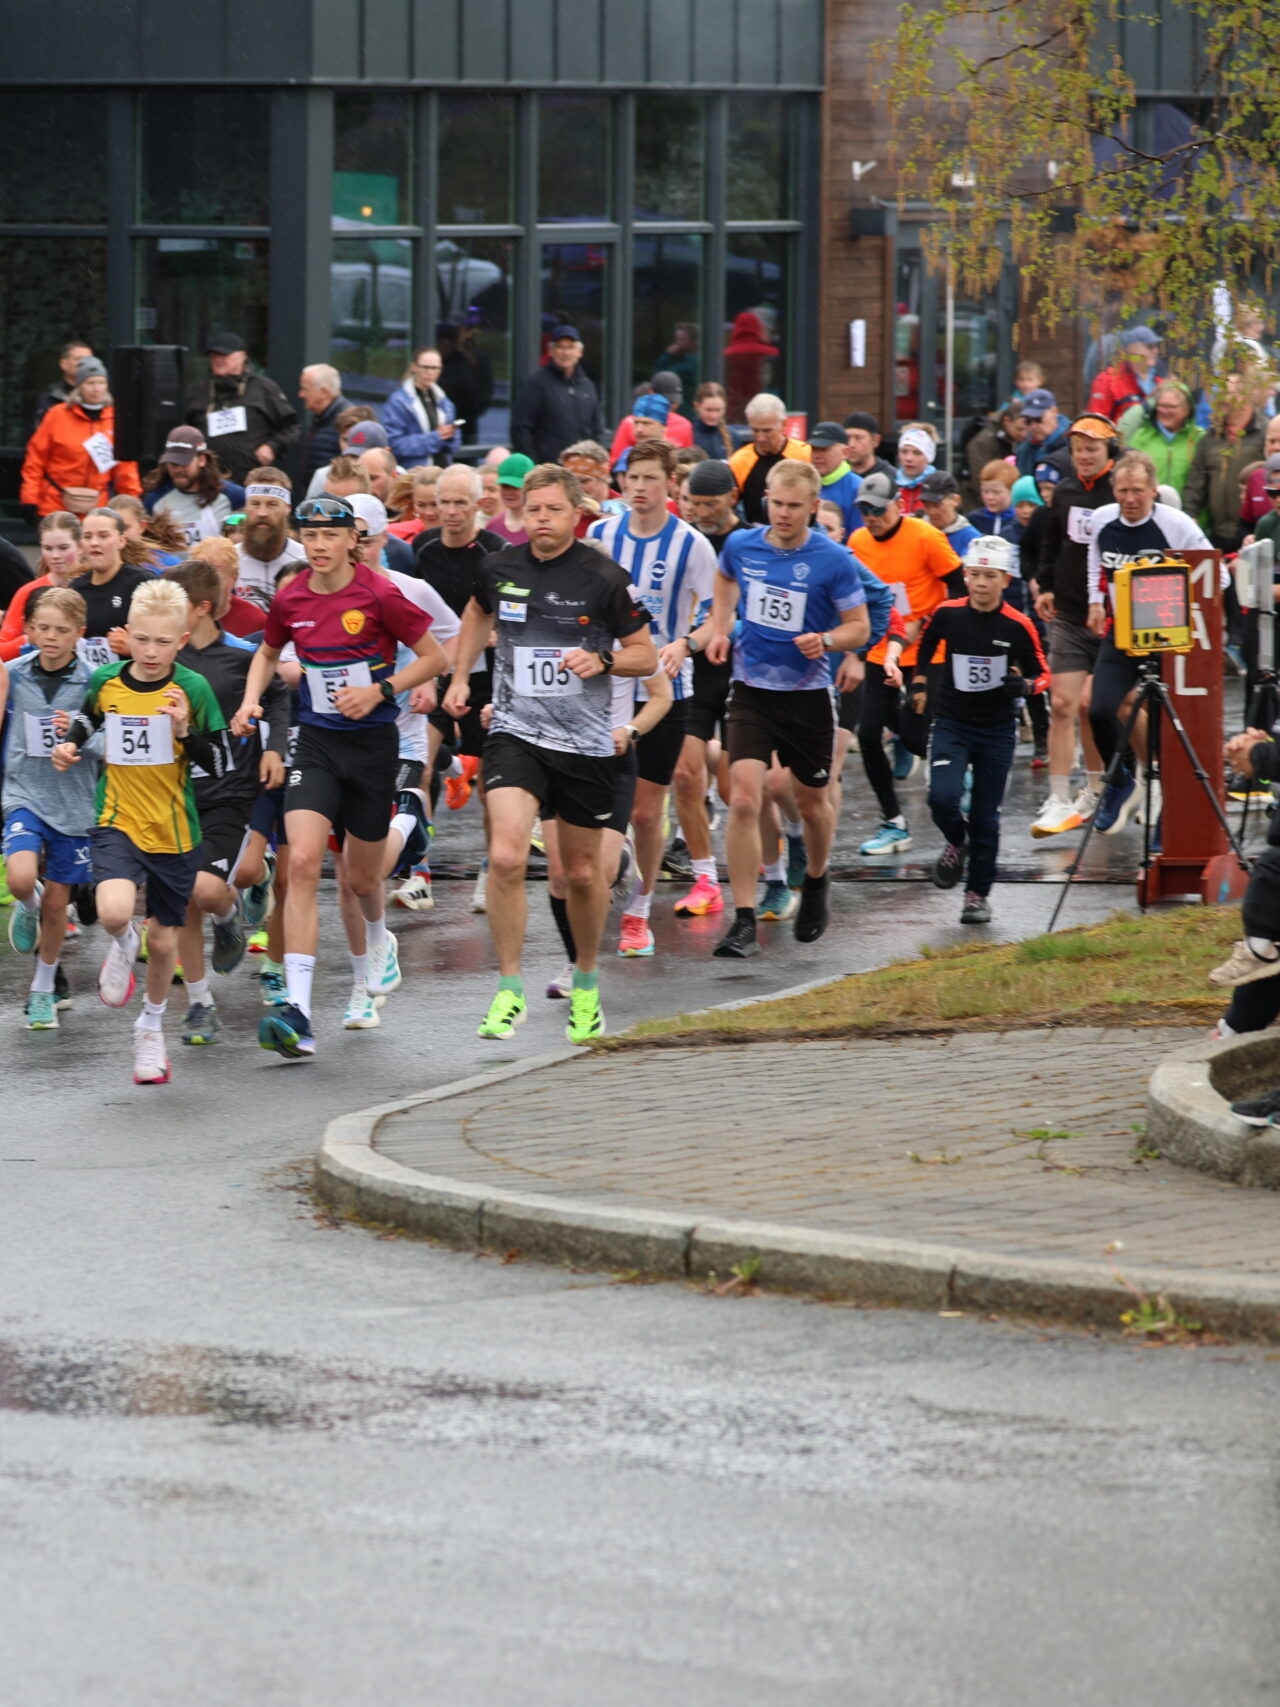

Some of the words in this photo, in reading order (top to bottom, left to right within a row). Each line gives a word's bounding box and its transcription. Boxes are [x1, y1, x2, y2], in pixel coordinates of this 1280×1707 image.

[759, 598, 792, 622] 153
[85, 647, 110, 664] 148
[527, 661, 570, 686] 105
[968, 666, 992, 684] 53
[122, 730, 151, 755] 54
